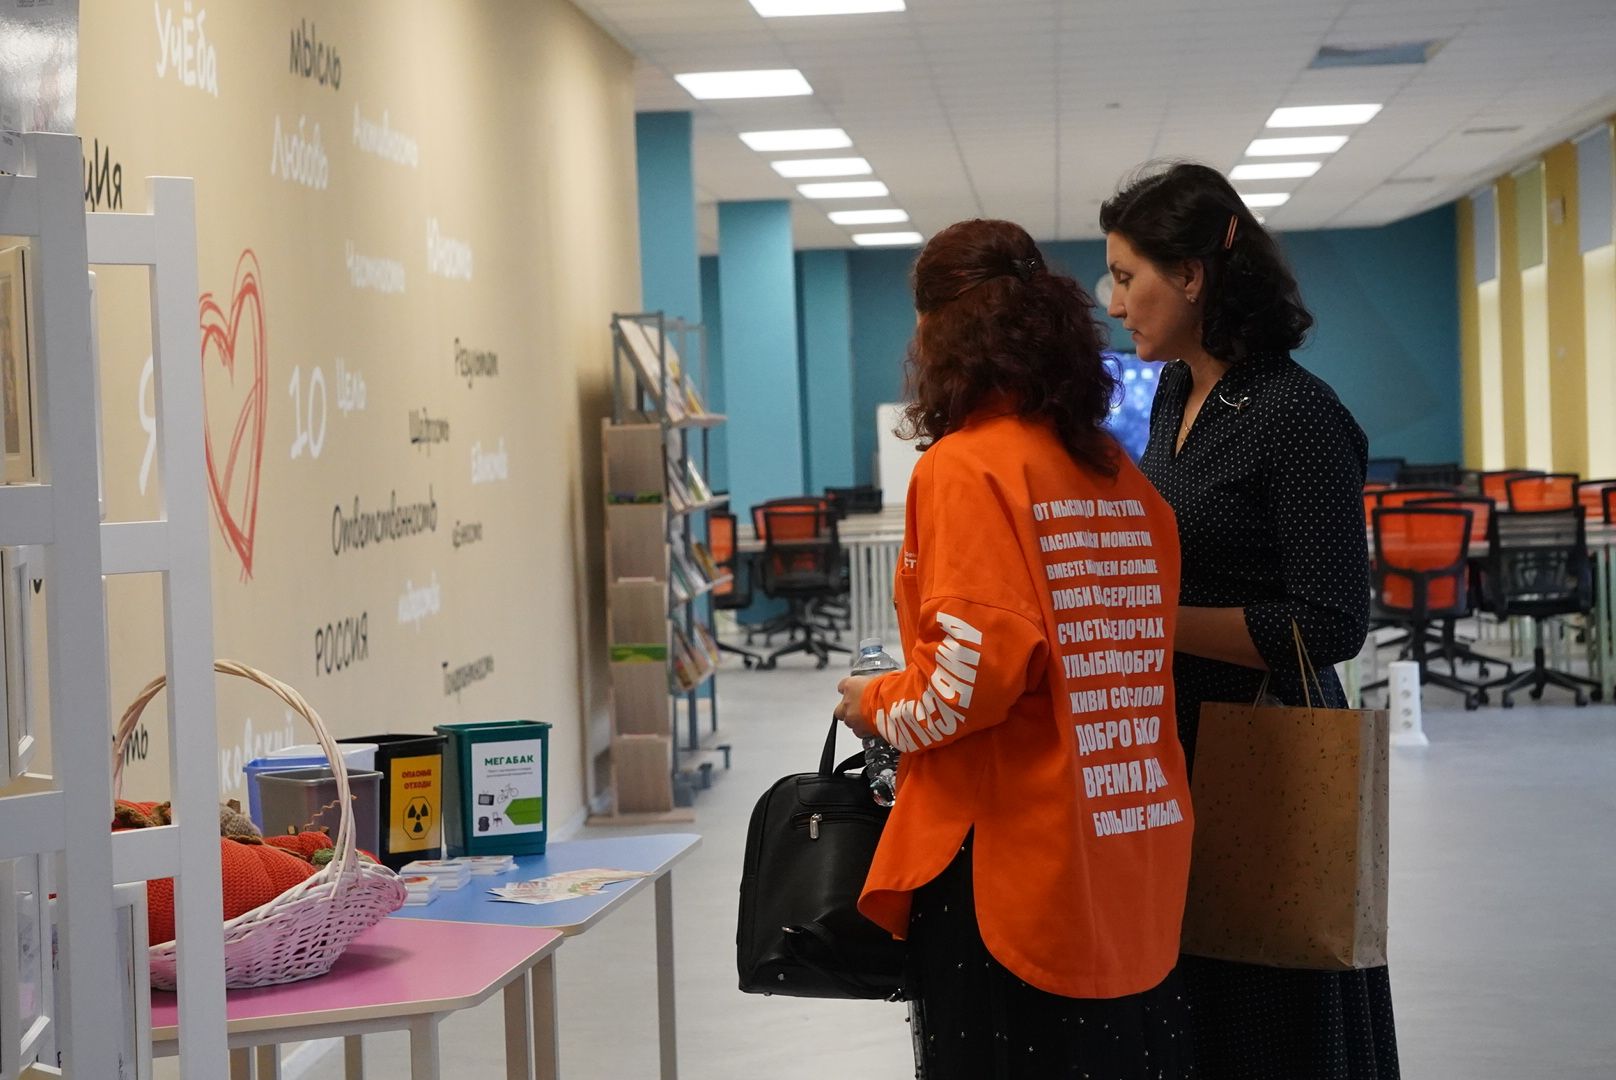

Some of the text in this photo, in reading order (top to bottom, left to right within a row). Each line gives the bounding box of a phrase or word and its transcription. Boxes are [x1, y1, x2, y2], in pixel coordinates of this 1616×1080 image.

[288, 364, 328, 460] 10
[1032, 502, 1050, 522] ОТ
[1046, 560, 1085, 581] ВМЕСТЕ
[1051, 586, 1093, 611] ЛЮБИ
[315, 611, 369, 678] РОССИЯ
[1070, 688, 1108, 714] ЖИВИ
[1075, 718, 1133, 757] ДОБРО
[484, 755, 534, 766] МЕГАБАК
[1082, 760, 1143, 799] ВРЕМЯ
[1092, 806, 1146, 838] БОЛЬШЕ
